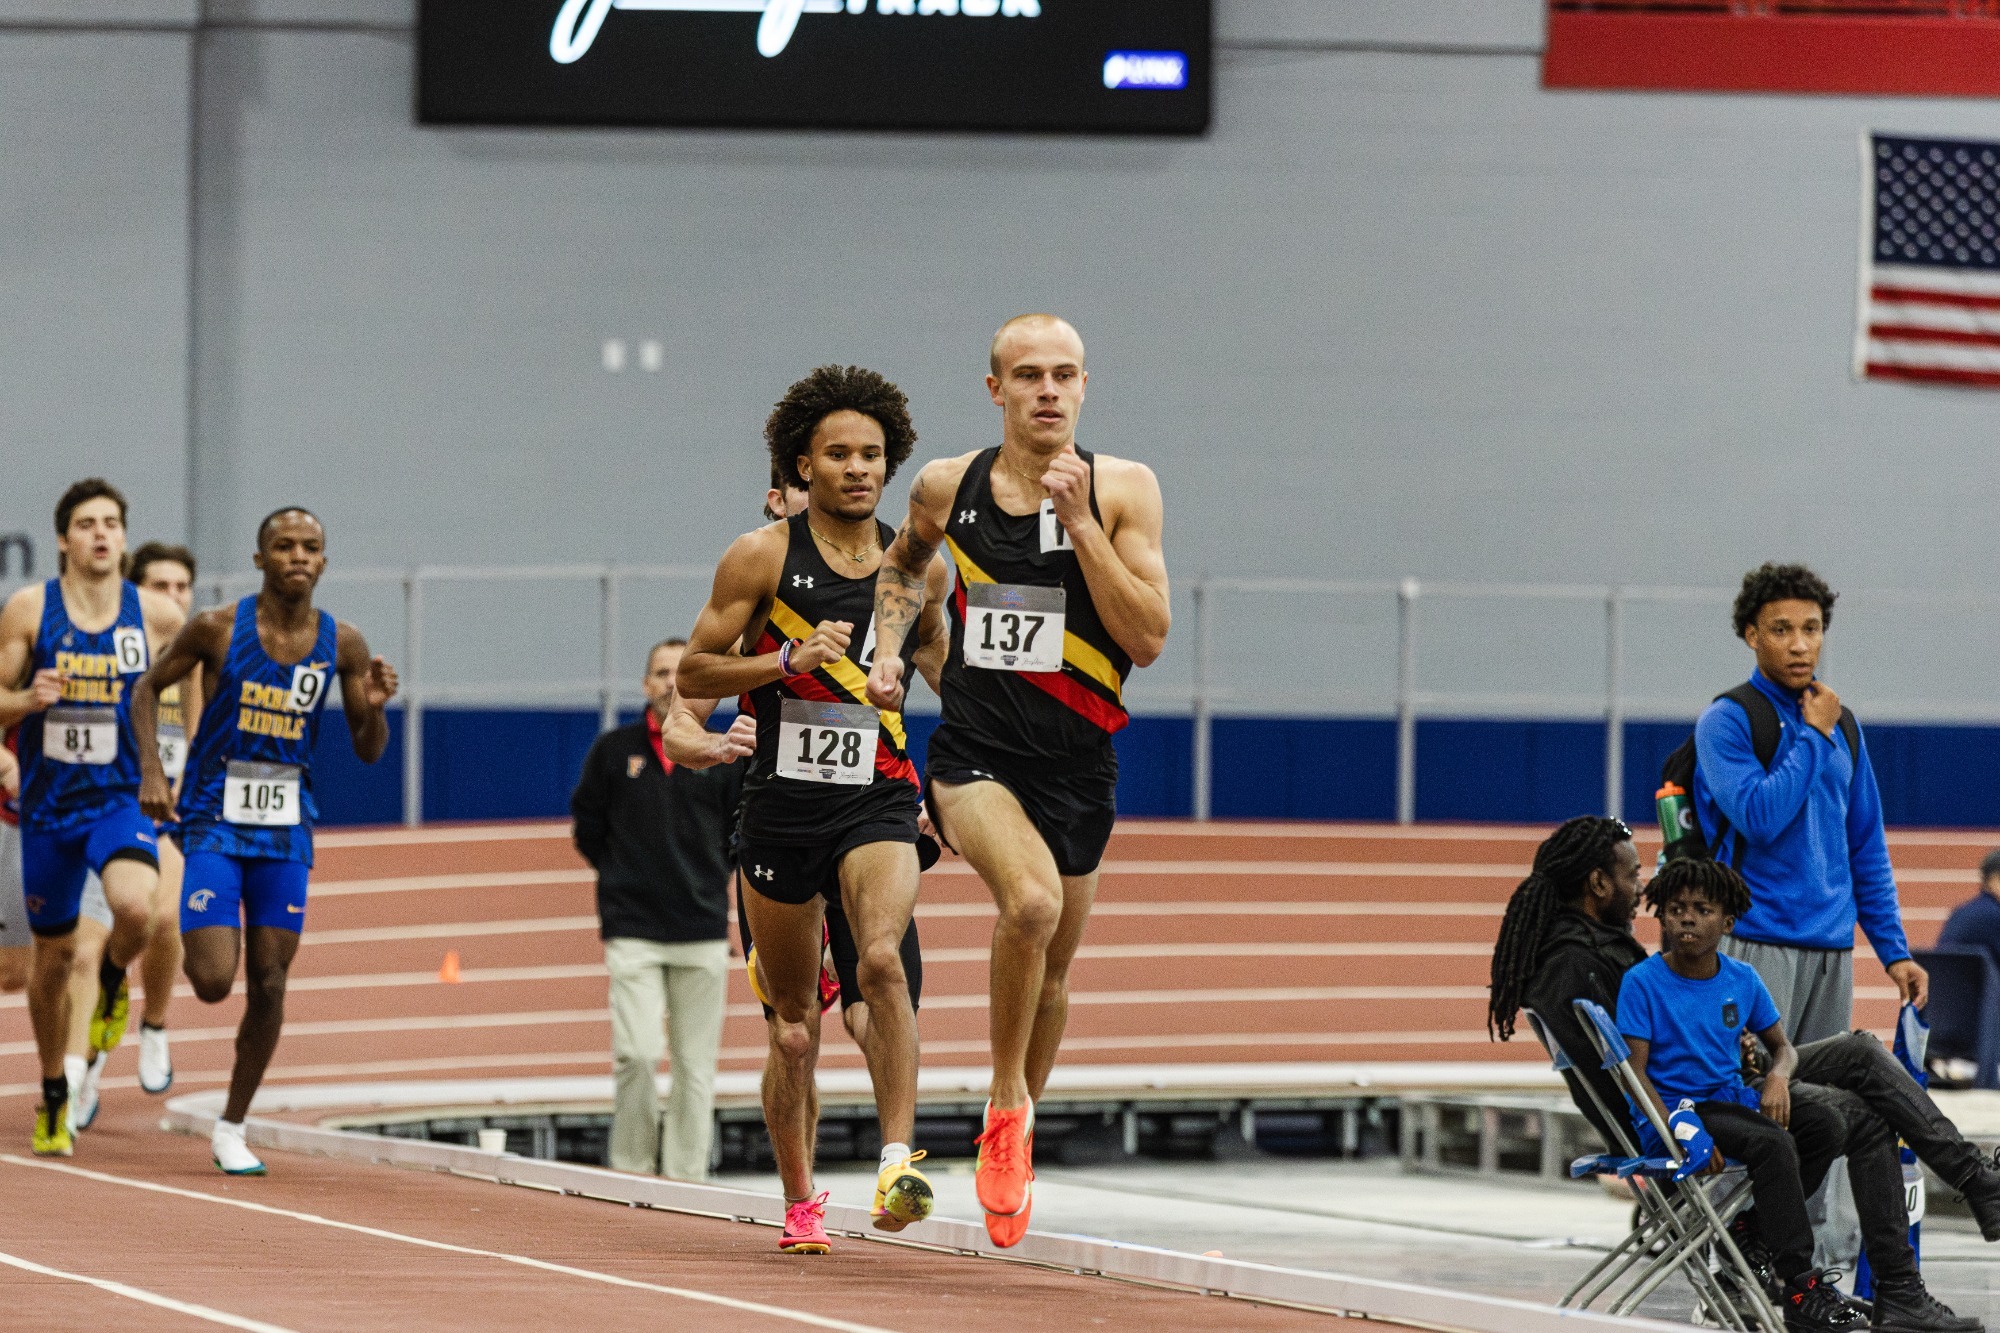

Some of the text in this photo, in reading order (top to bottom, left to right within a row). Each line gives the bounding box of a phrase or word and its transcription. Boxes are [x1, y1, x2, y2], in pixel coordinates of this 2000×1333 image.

[980, 612, 1045, 653] 137
[120, 635, 141, 668] 6
[294, 672, 319, 707] 9
[64, 727, 93, 751] 81
[797, 728, 862, 768] 128
[239, 783, 286, 811] 105
